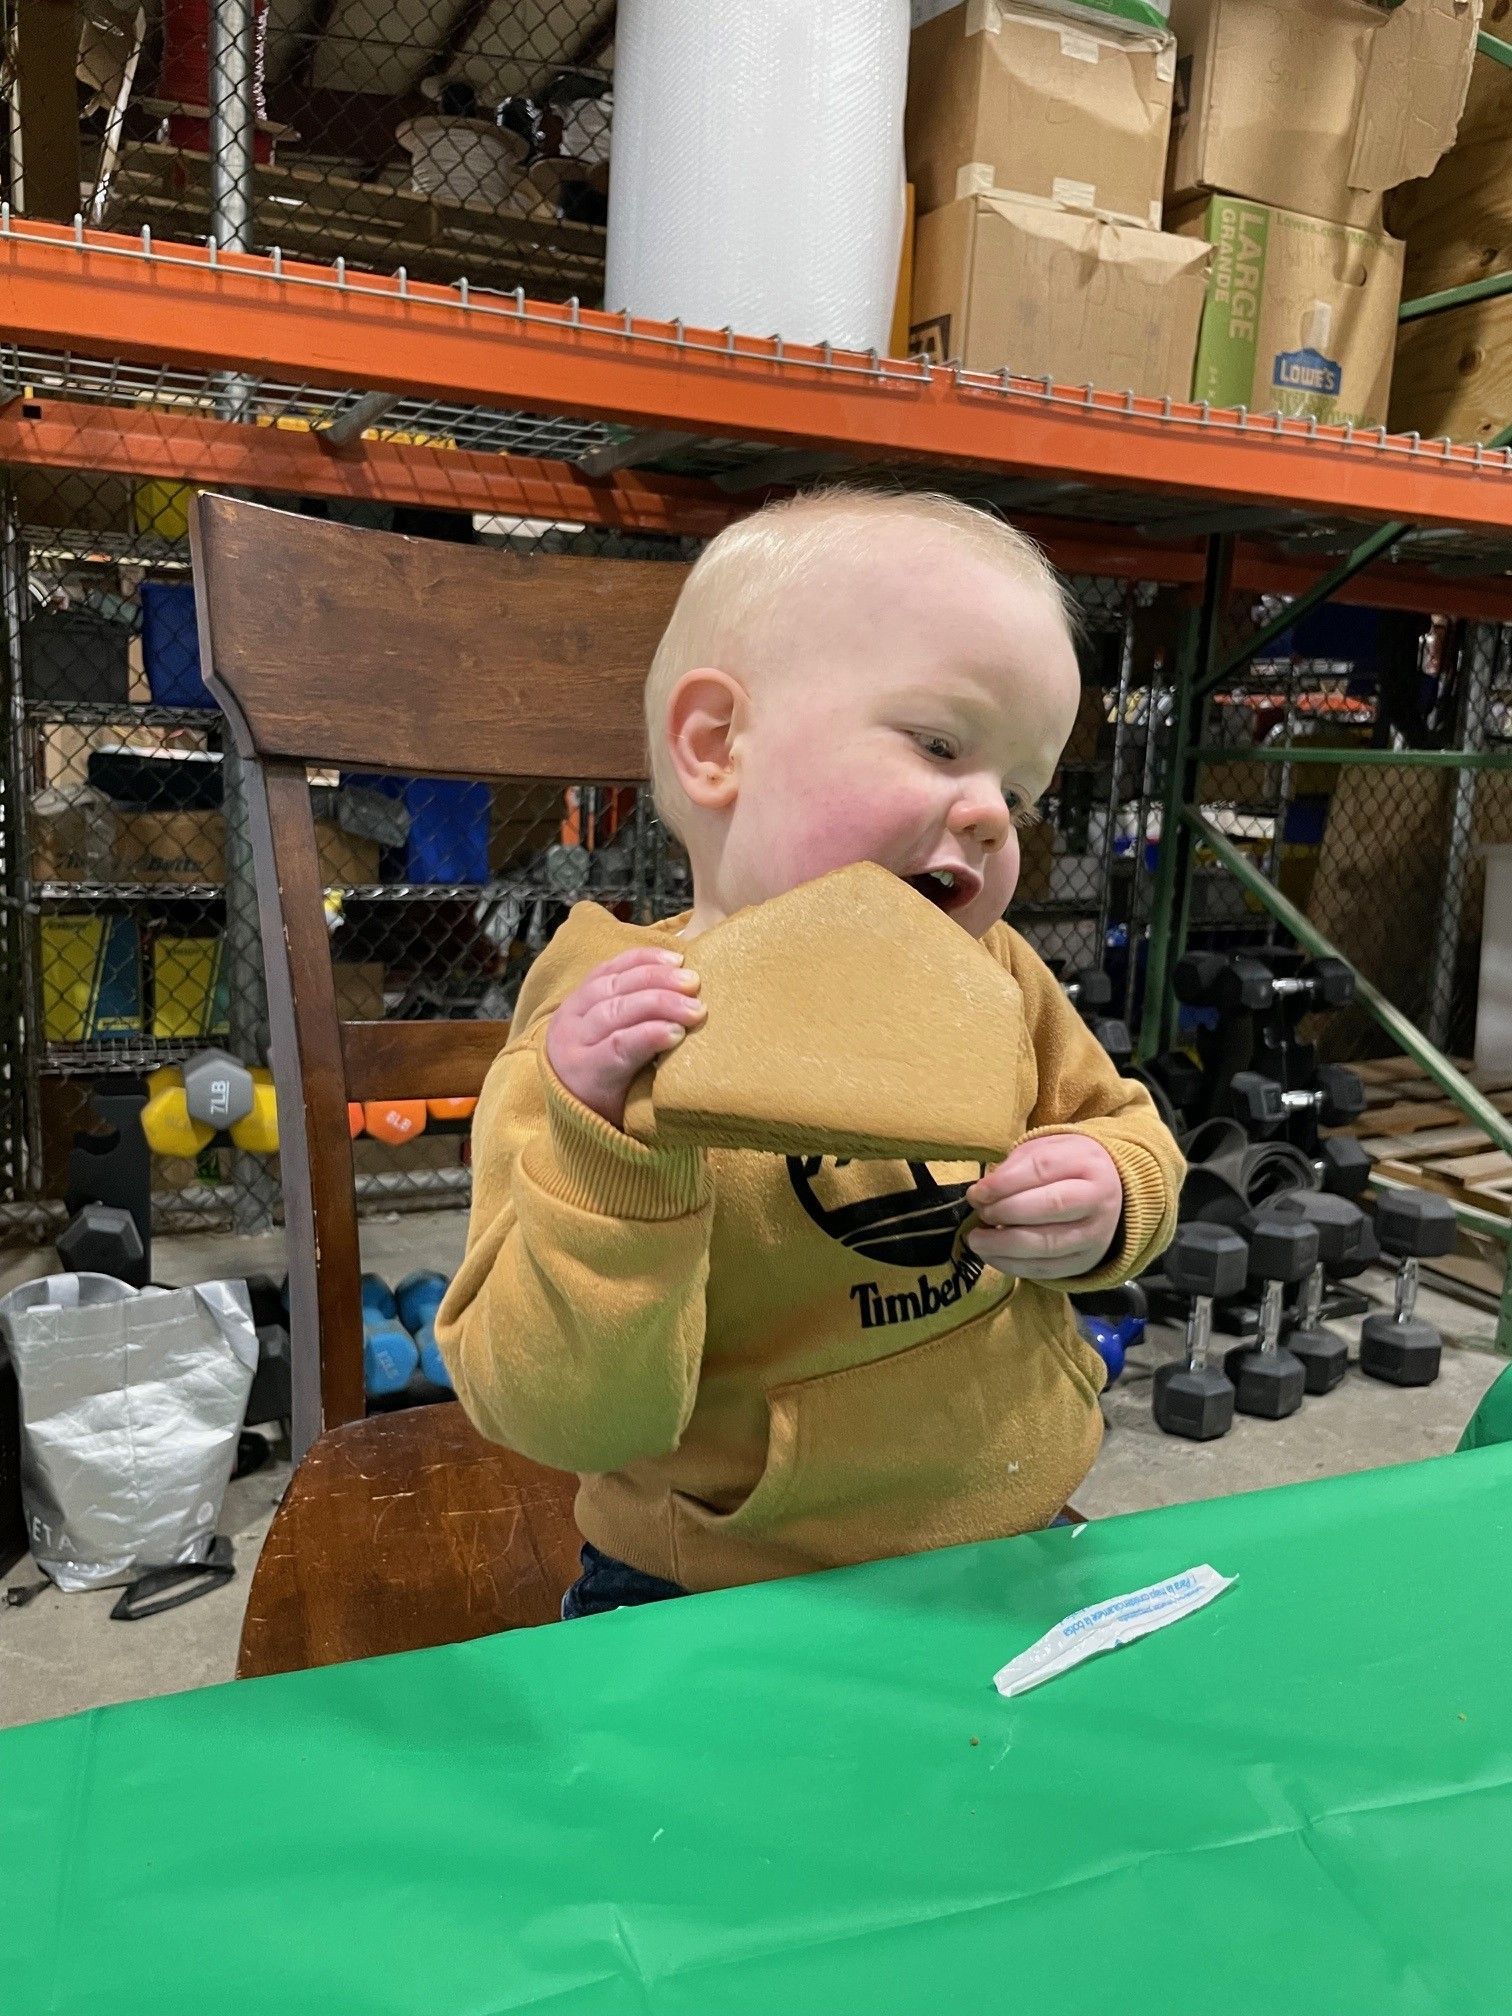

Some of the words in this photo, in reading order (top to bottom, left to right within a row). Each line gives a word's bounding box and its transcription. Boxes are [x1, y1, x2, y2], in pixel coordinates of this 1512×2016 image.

[1214, 207, 1238, 304] GRANDE
[1228, 210, 1265, 341] LARGE
[1279, 358, 1336, 389] LOWE'S
[210, 1079, 229, 1115] 7LB
